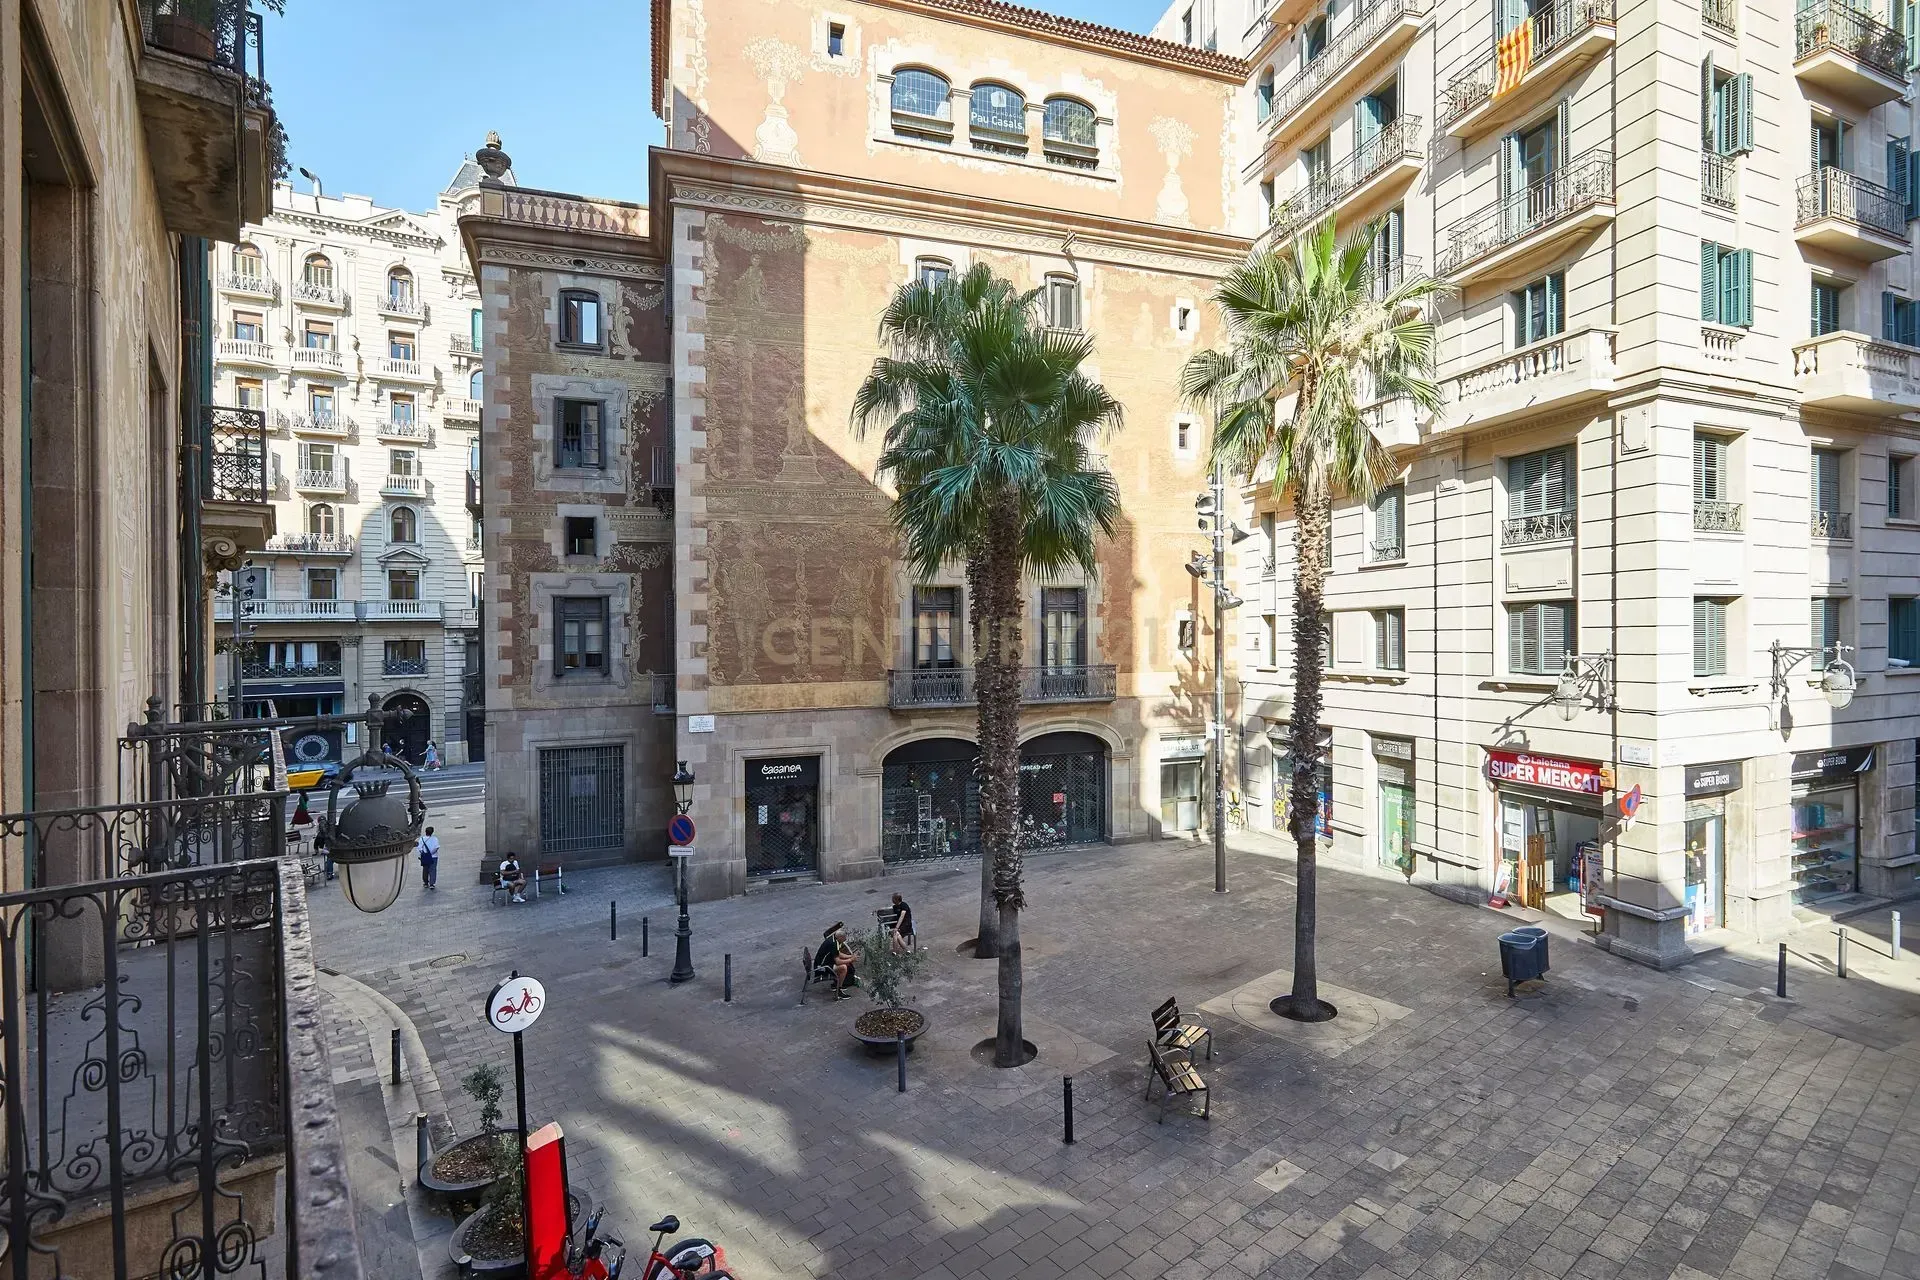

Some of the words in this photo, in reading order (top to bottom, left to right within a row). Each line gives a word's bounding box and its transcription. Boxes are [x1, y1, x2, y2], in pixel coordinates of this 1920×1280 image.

[971, 112, 989, 123] Pau
[992, 116, 1023, 129] Casals
[1383, 744, 1398, 753] SUPER
[1399, 746, 1411, 754] BUSH
[1823, 758, 1835, 767] SUPER
[1491, 760, 1535, 781] SUPER
[1538, 767, 1600, 792] MERCAT
[1700, 777, 1715, 787] SUPER
[1715, 775, 1730, 785] BUSH
